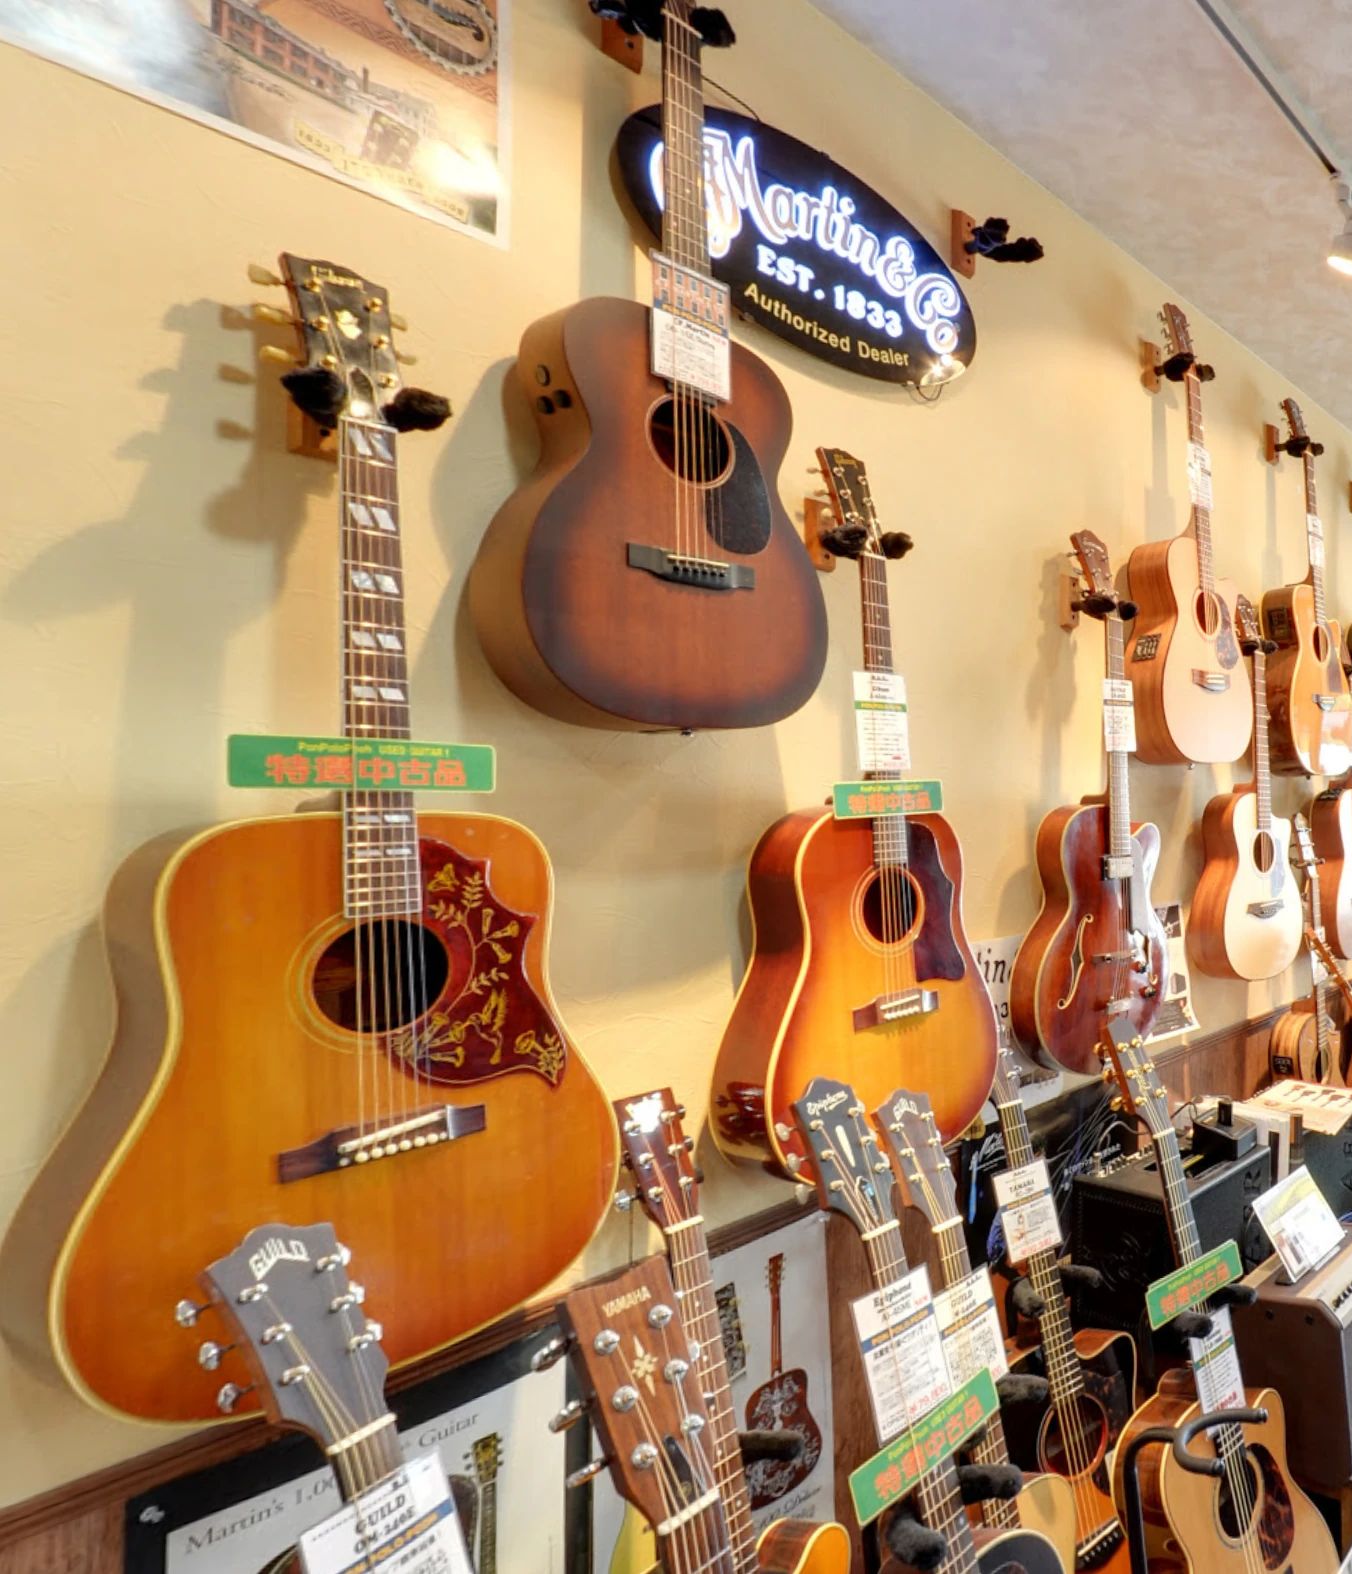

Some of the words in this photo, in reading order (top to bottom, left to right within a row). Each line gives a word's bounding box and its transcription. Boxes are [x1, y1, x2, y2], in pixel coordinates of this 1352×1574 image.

[703, 127, 881, 277] Martin
[875, 236, 917, 298] &
[756, 243, 826, 301] EST.
[833, 284, 904, 339] 1833
[744, 282, 851, 353] Authorized
[857, 340, 910, 368] Dealer
[265, 753, 467, 787] 特選中古品
[249, 1237, 311, 1281] GUILD
[601, 1285, 652, 1318] YAMAHA
[185, 1499, 285, 1556] Martin's
[418, 1412, 480, 1450] Guitar
[355, 1494, 406, 1534] GUILD
